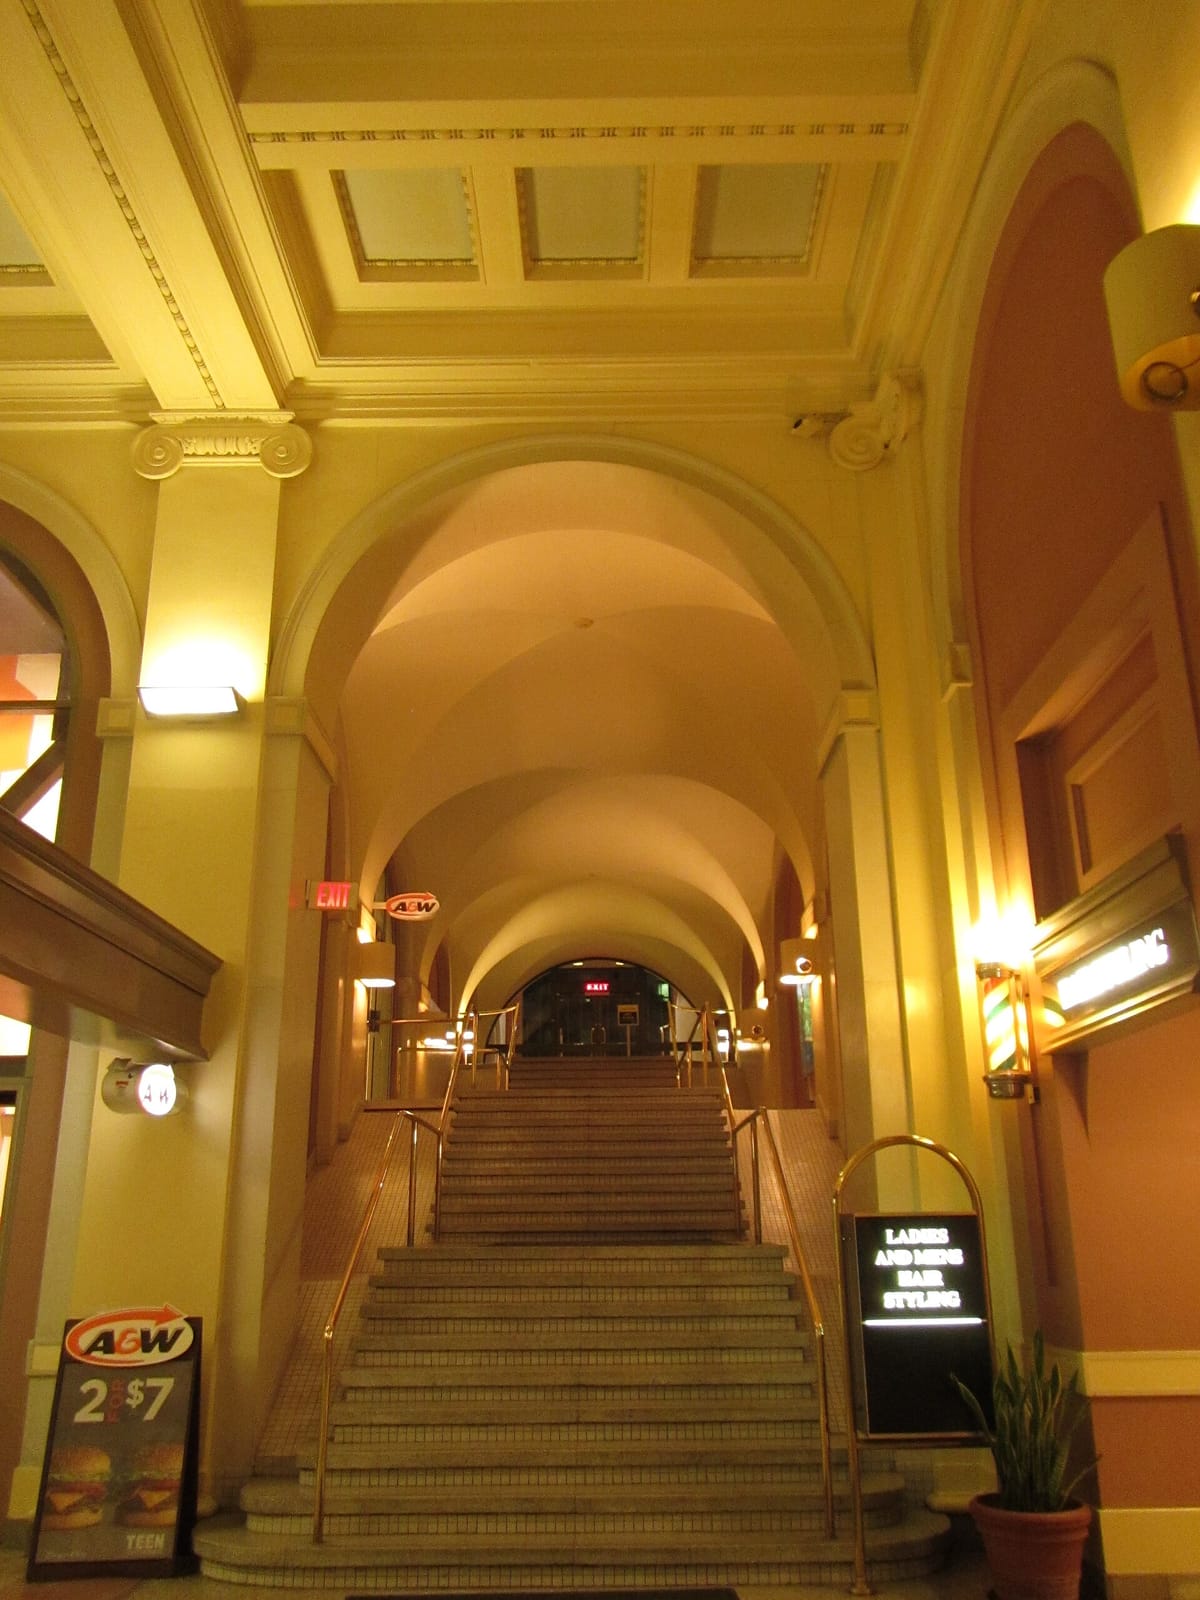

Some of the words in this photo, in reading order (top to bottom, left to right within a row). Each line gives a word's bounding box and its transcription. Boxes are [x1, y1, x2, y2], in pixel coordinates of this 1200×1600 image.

[317, 882, 352, 908] EXIT
[394, 902, 437, 913] A&W
[586, 983, 609, 991] EXIT
[875, 1249, 913, 1266] AND
[897, 1269, 945, 1288] HAIR
[883, 1290, 961, 1309] STYLING
[81, 1327, 185, 1355] A&W
[74, 1378, 108, 1423] 2
[126, 1533, 166, 1551] TEEN
